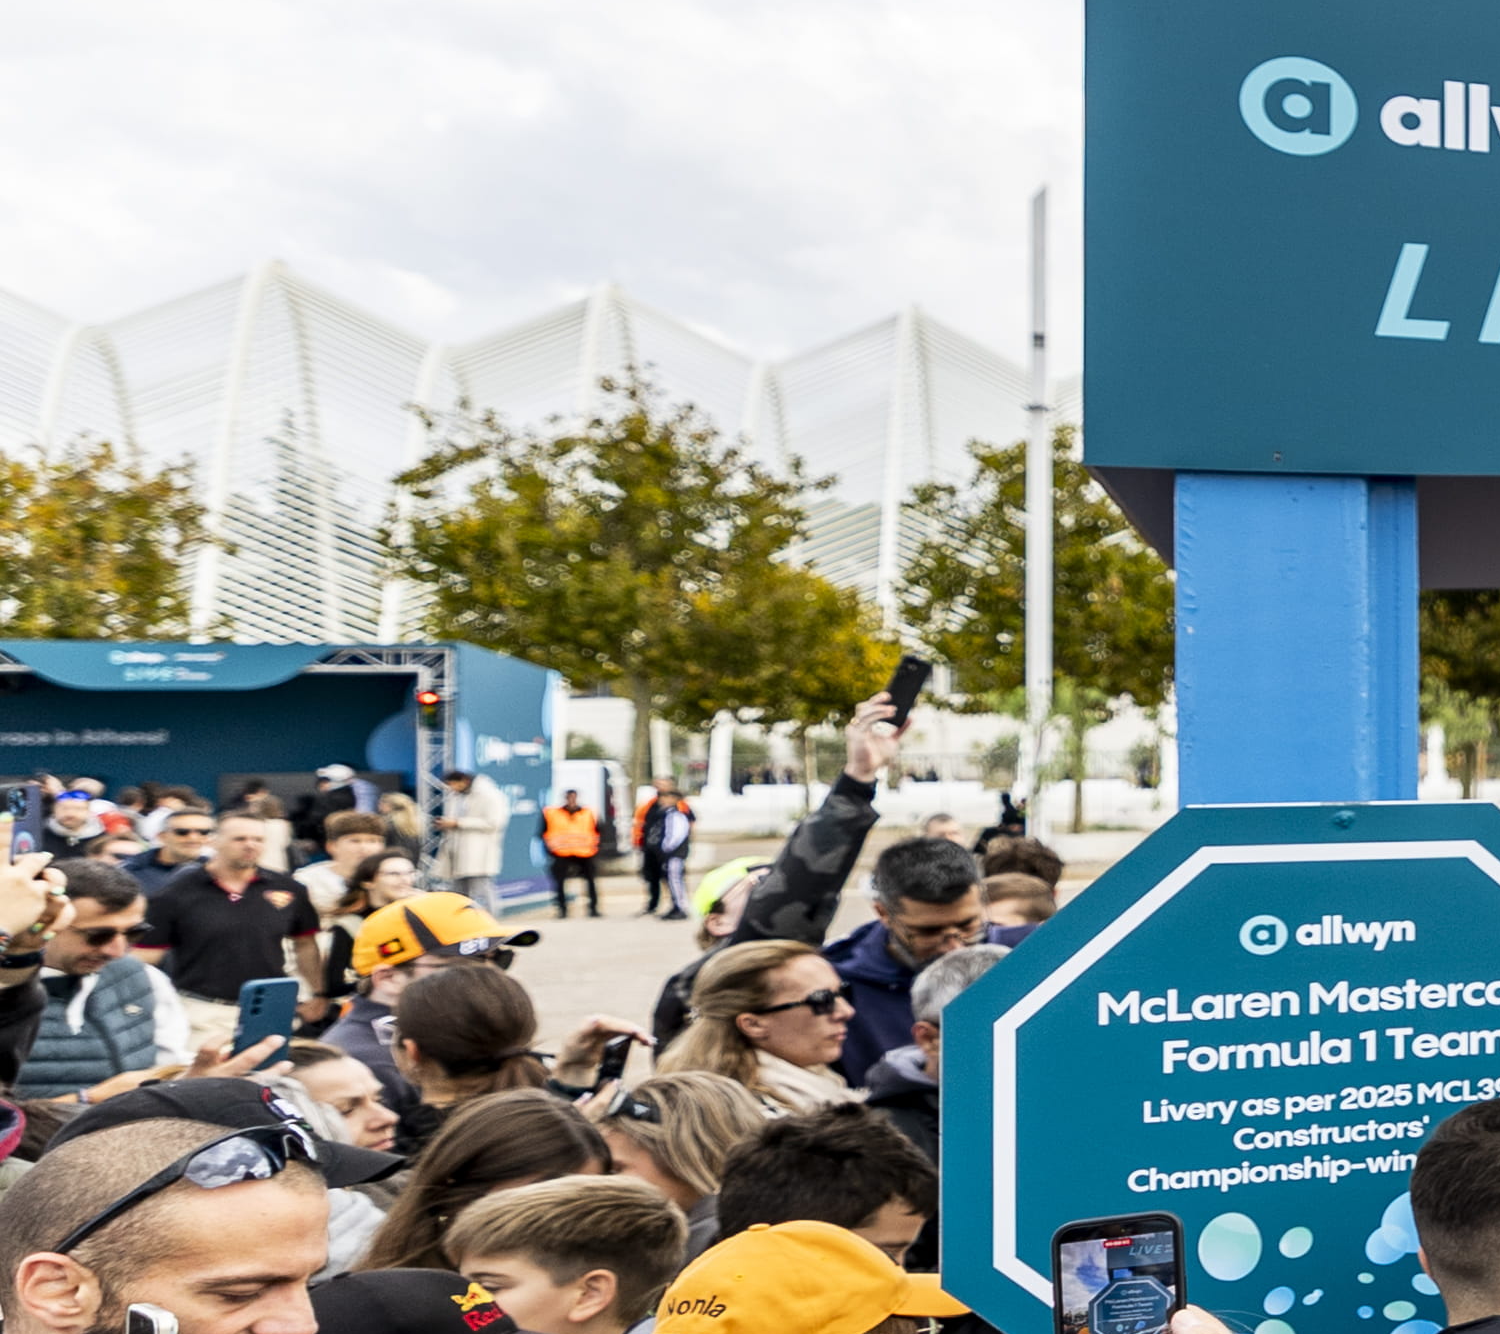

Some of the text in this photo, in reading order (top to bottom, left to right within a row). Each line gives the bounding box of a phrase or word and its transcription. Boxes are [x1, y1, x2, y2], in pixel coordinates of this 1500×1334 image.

[1295, 914, 1416, 952] allwyn
[1098, 988, 1300, 1026] McLaren
[1162, 1030, 1352, 1074] Formula
[1359, 1029, 1378, 1062] 1
[1142, 1098, 1238, 1125] Livery
[1241, 1097, 1281, 1117] as
[1284, 1091, 1337, 1120] per
[1340, 1083, 1413, 1111] 2025
[1233, 1115, 1430, 1151] Constructors'
